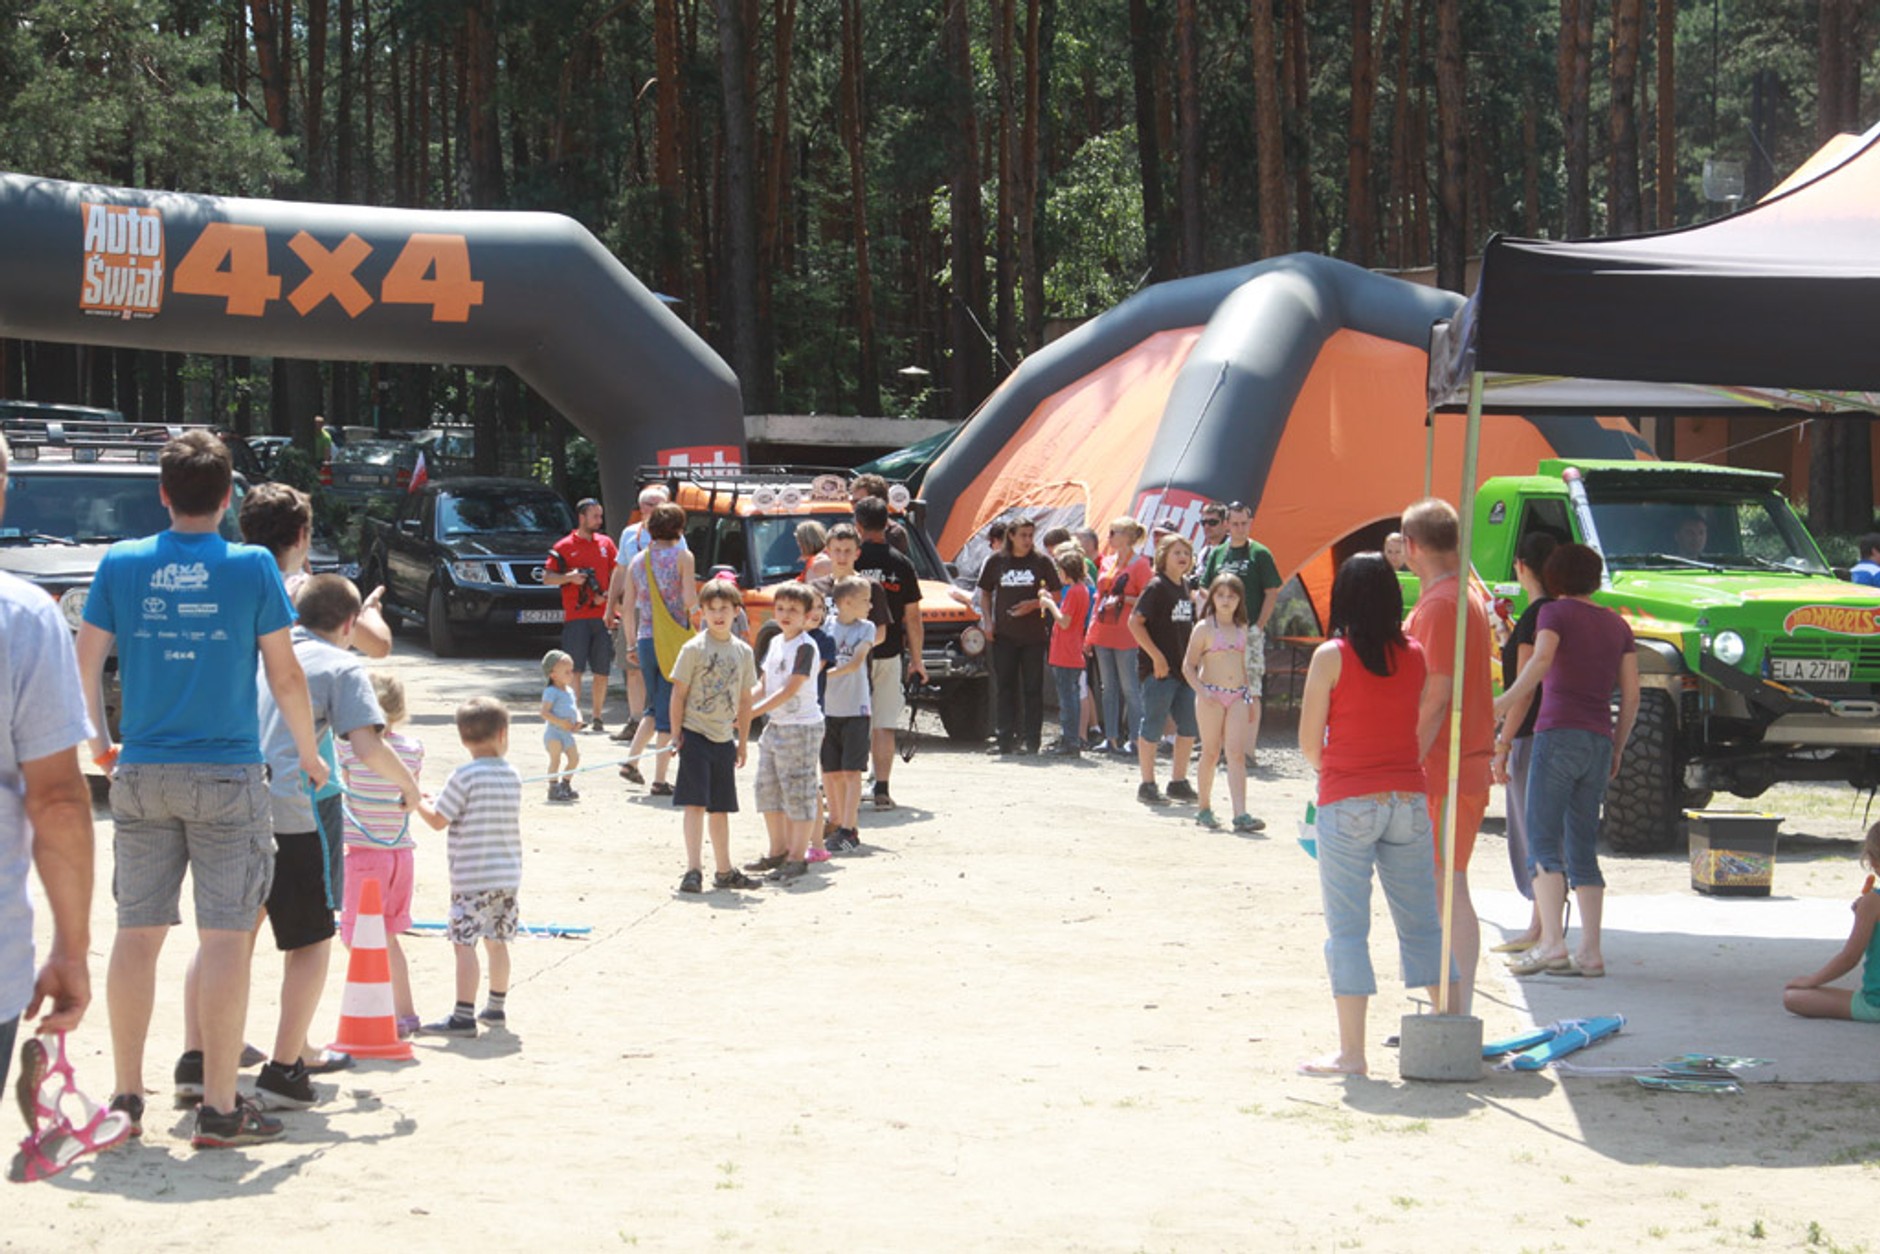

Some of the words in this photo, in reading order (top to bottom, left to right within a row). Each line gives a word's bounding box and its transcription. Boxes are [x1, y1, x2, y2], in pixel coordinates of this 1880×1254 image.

[84, 205, 161, 257] Auto
[83, 255, 163, 308] Świat
[172, 221, 485, 323] 4x4
[1772, 661, 1804, 679] ELA
[1809, 661, 1848, 679] 27HW
